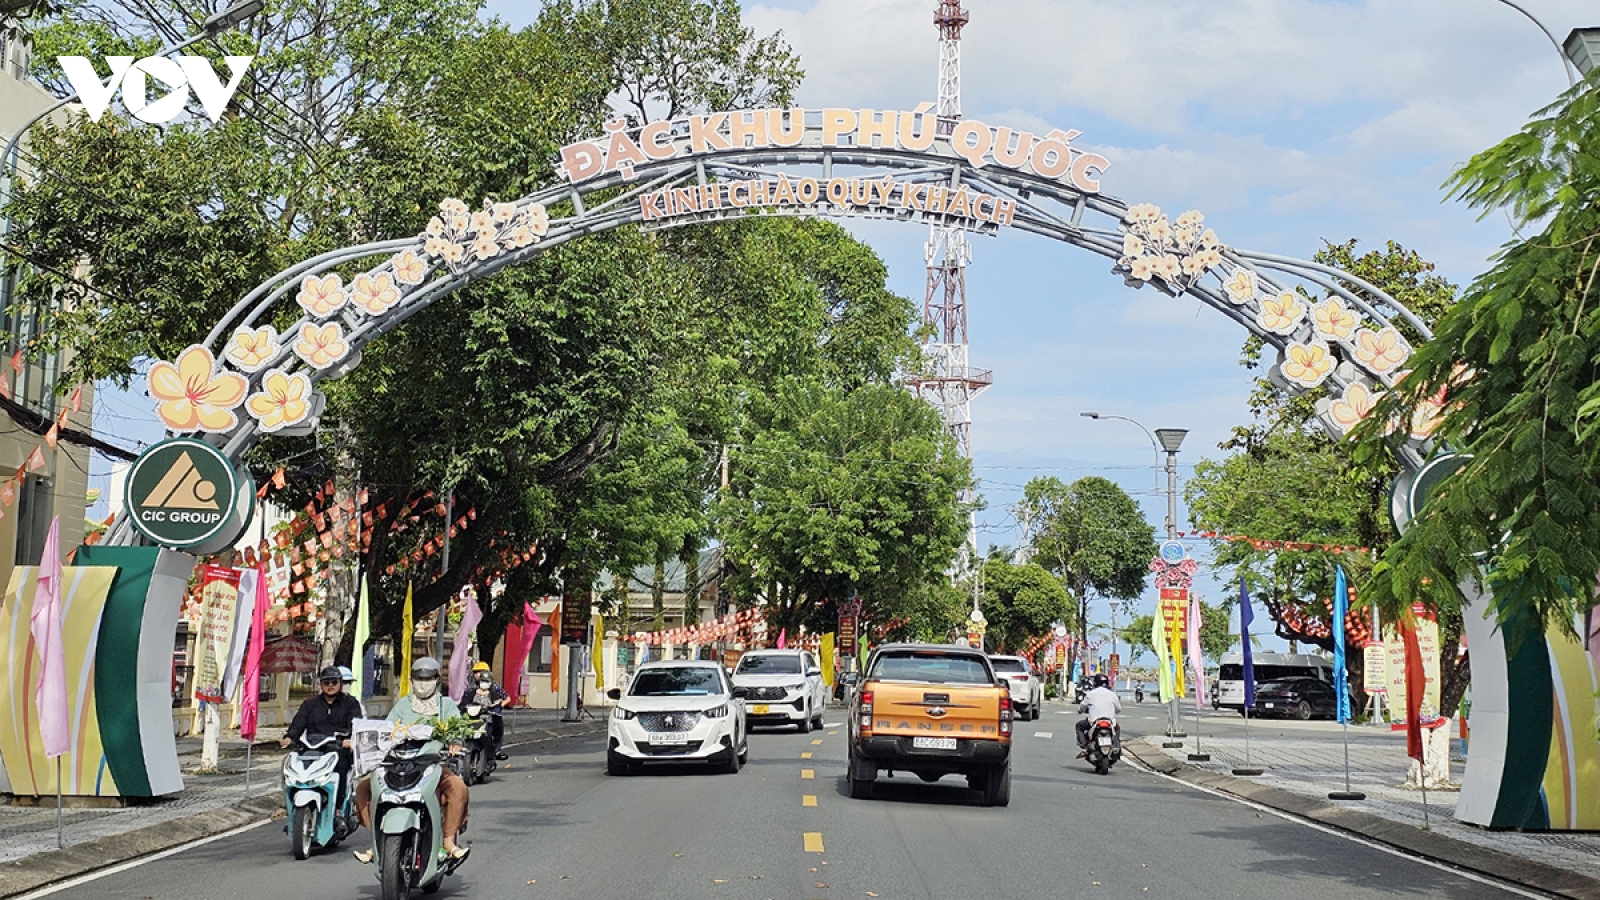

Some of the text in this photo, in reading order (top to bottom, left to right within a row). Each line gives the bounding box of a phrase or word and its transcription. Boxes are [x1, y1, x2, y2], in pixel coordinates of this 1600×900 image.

[559, 101, 1112, 194] ĐẶC KHU PHÚ QUỐC
[639, 171, 1017, 227] KÍNH CHÀO QUÝ KHÁCH
[141, 510, 221, 524] CIC GROUP
[877, 721, 995, 733] RANGER
